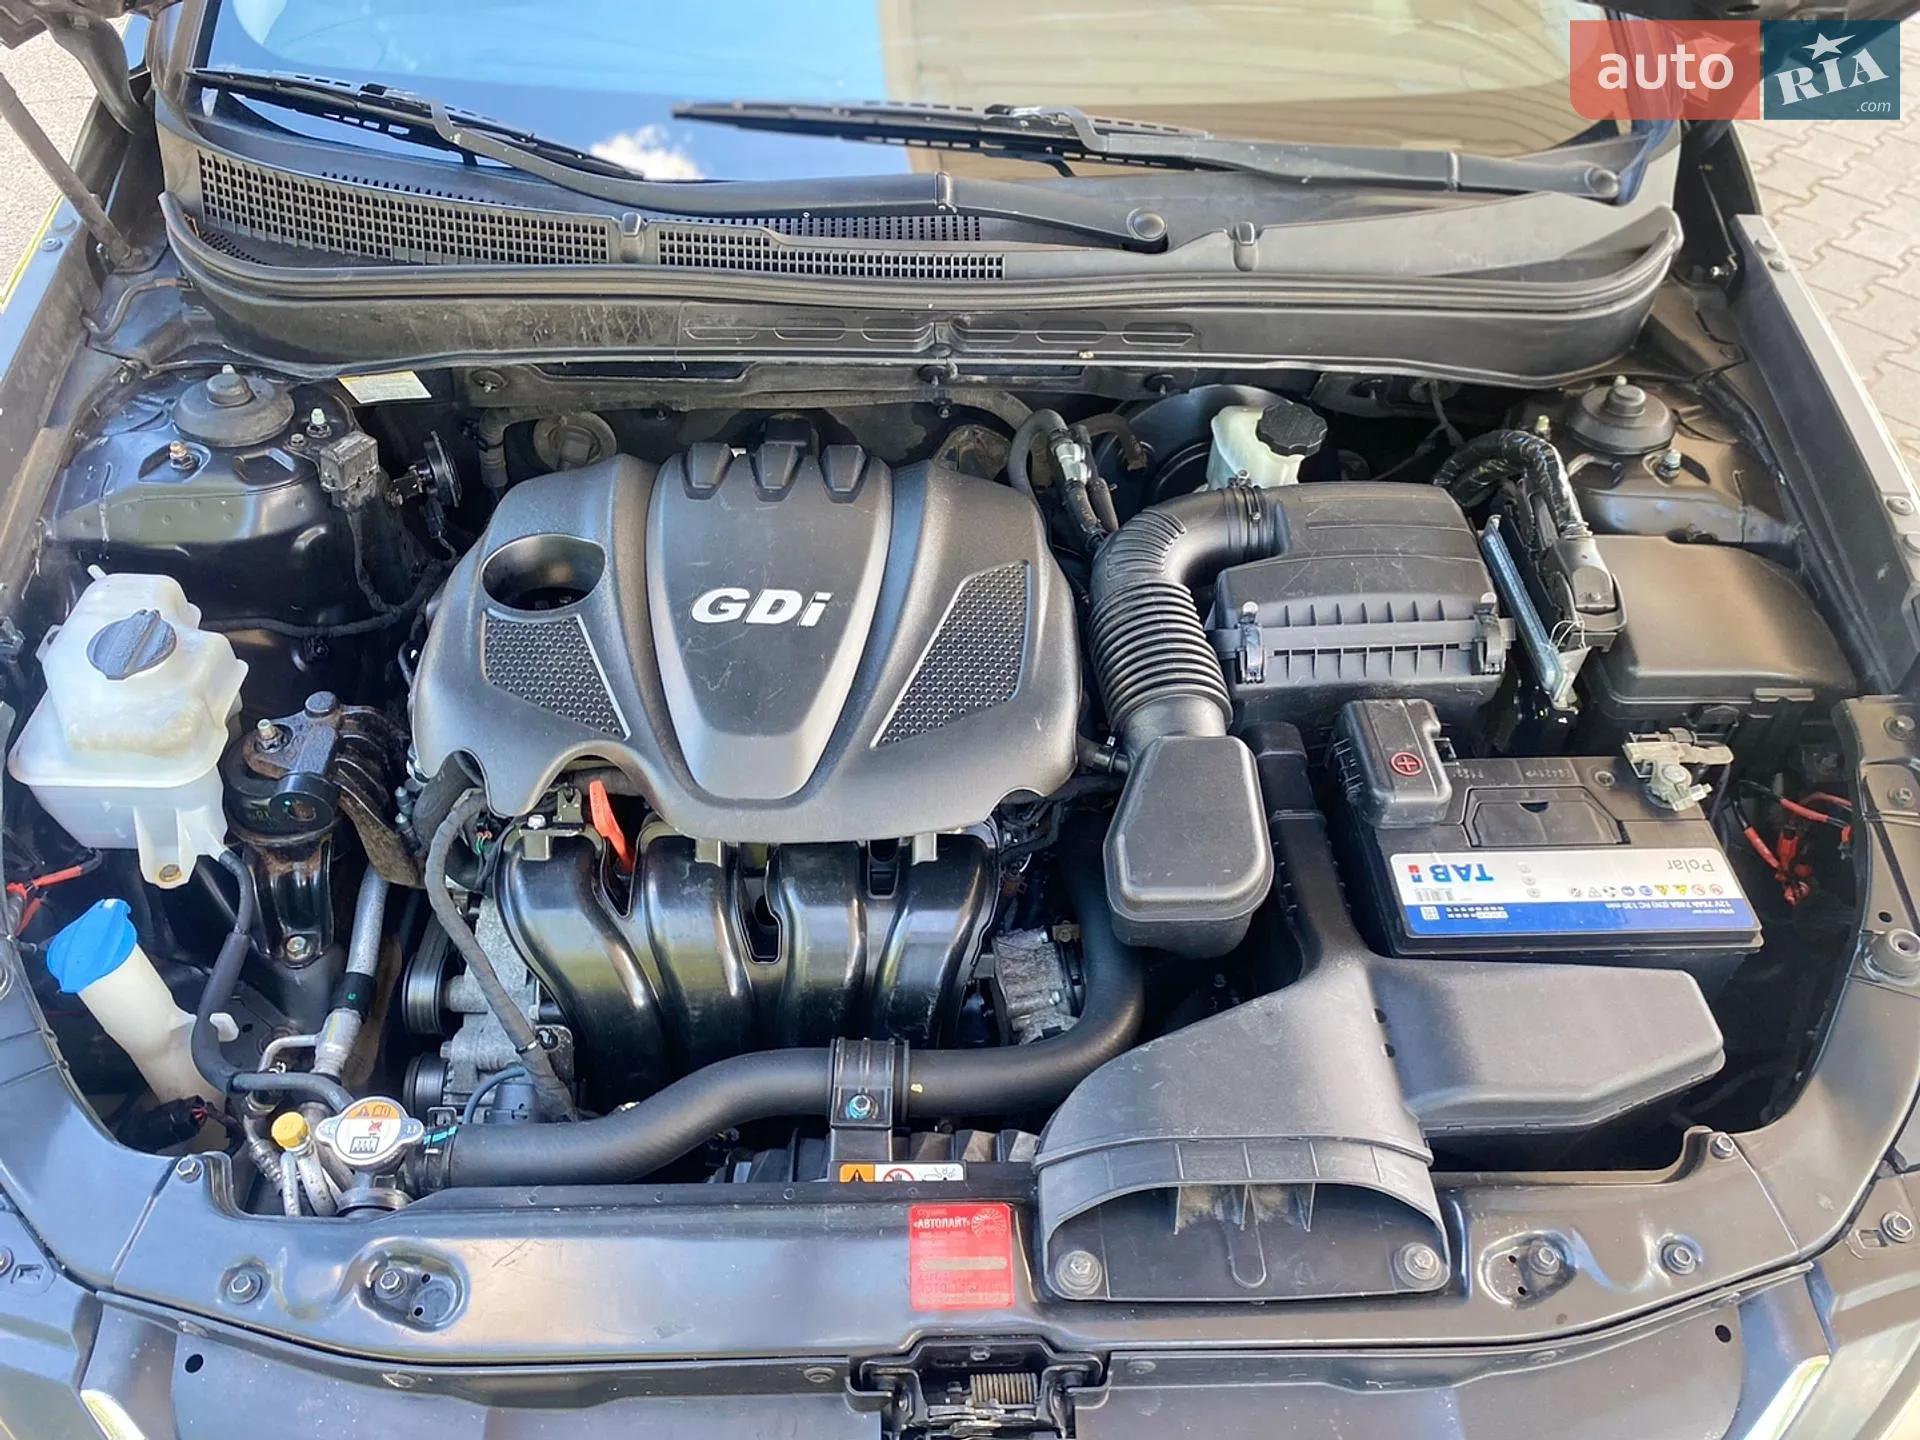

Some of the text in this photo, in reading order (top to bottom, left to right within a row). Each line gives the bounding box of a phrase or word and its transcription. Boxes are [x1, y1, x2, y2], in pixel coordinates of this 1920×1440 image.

[691, 587, 833, 627] GDi
[1429, 863, 1494, 882] TAB
[1666, 858, 1715, 873] Polar
